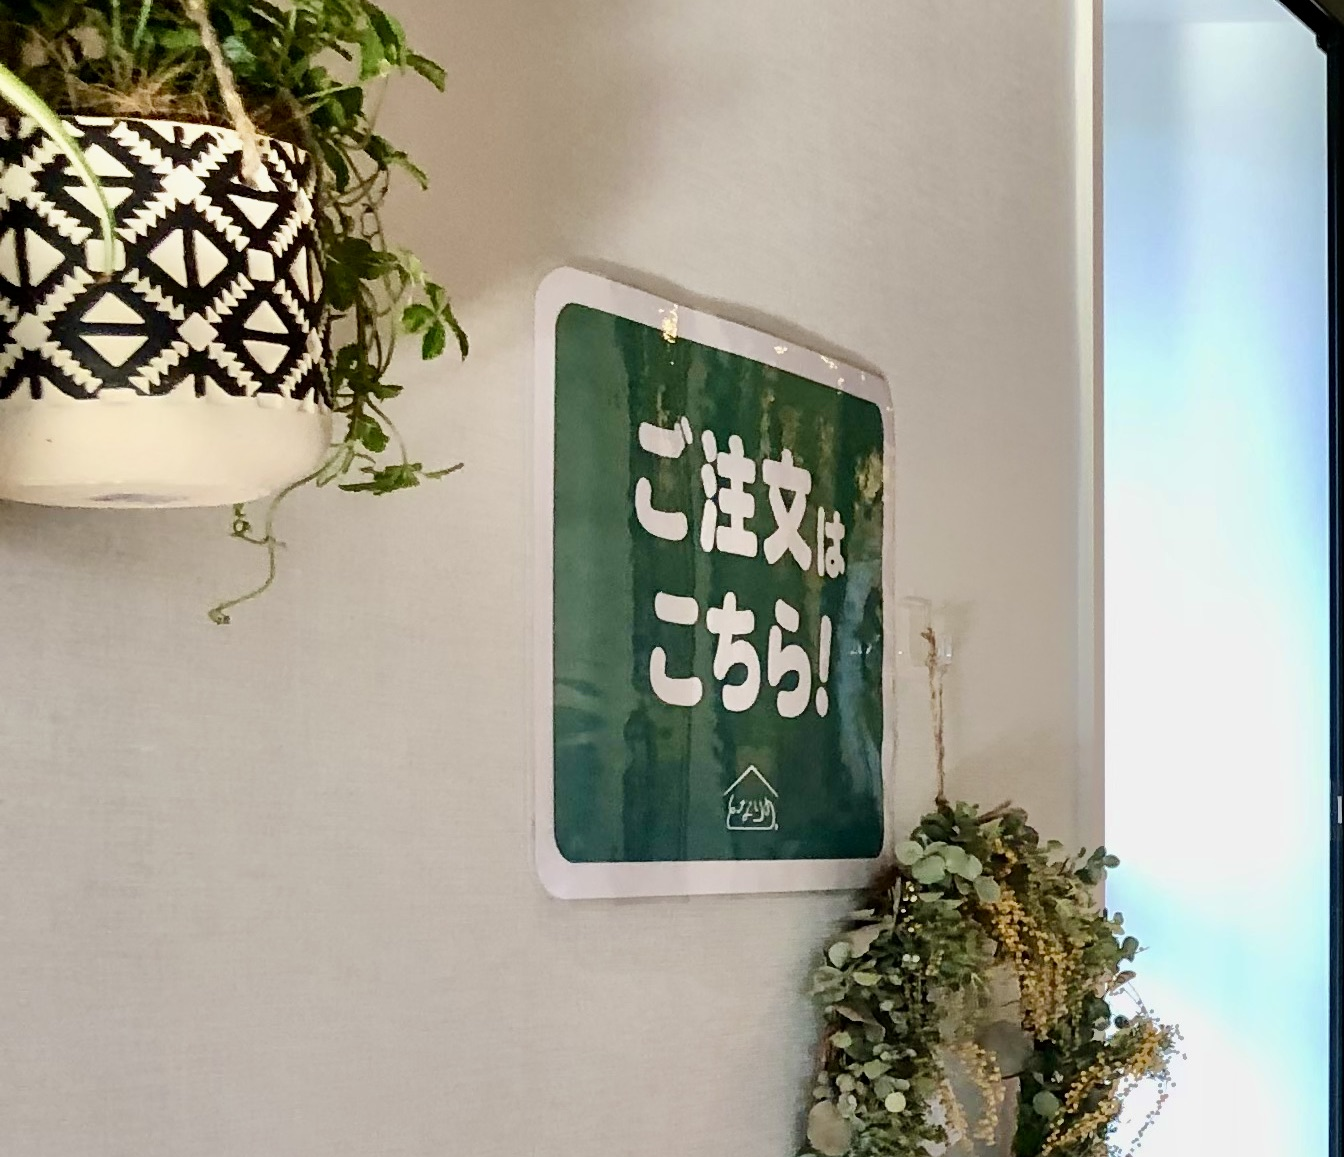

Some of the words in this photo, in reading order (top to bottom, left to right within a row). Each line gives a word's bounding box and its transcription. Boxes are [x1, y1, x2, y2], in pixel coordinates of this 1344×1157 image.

[635, 416, 846, 579] ご注文は
[650, 591, 832, 718] こちら!
